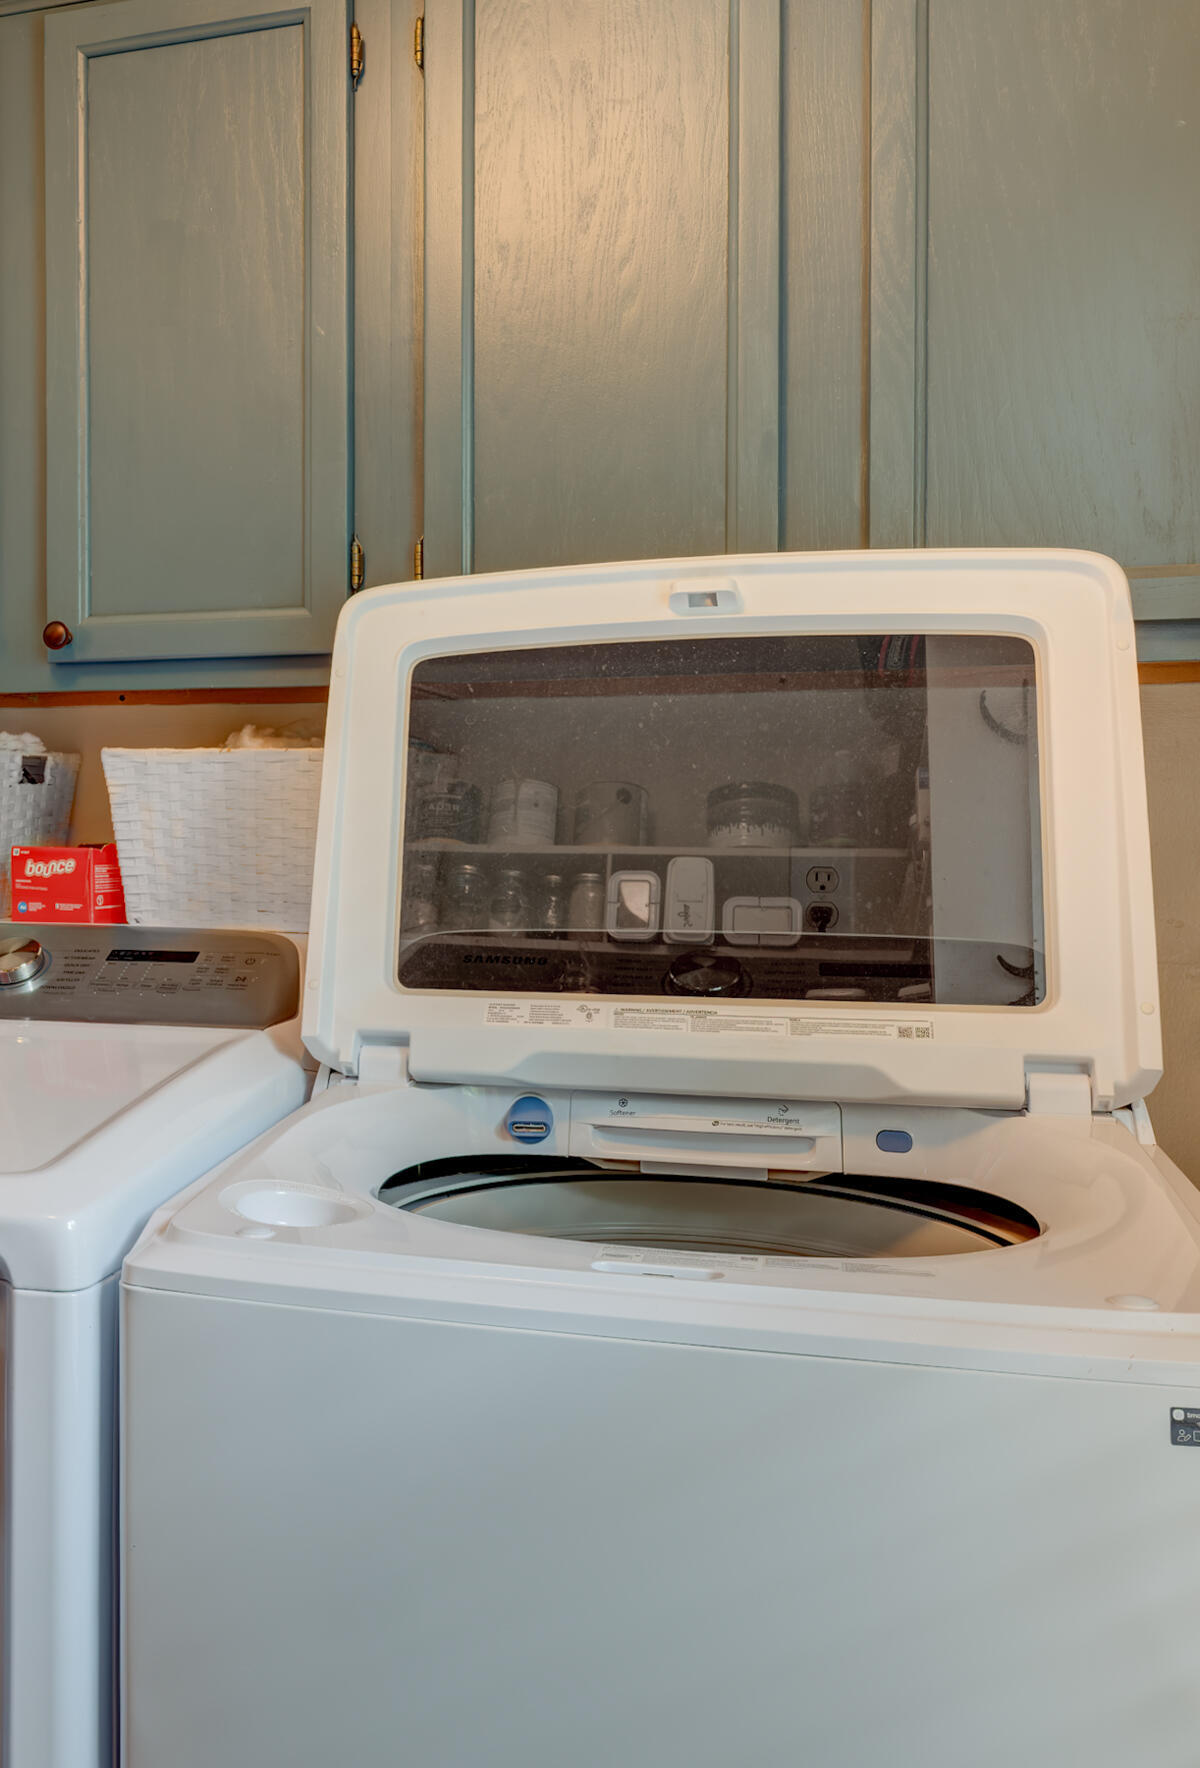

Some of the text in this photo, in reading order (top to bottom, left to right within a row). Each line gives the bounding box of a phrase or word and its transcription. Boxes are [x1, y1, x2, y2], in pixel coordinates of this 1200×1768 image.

[25, 858, 76, 878] bounce
[463, 954, 548, 966] SAMSUNG
[767, 1116, 800, 1125] Detergent
